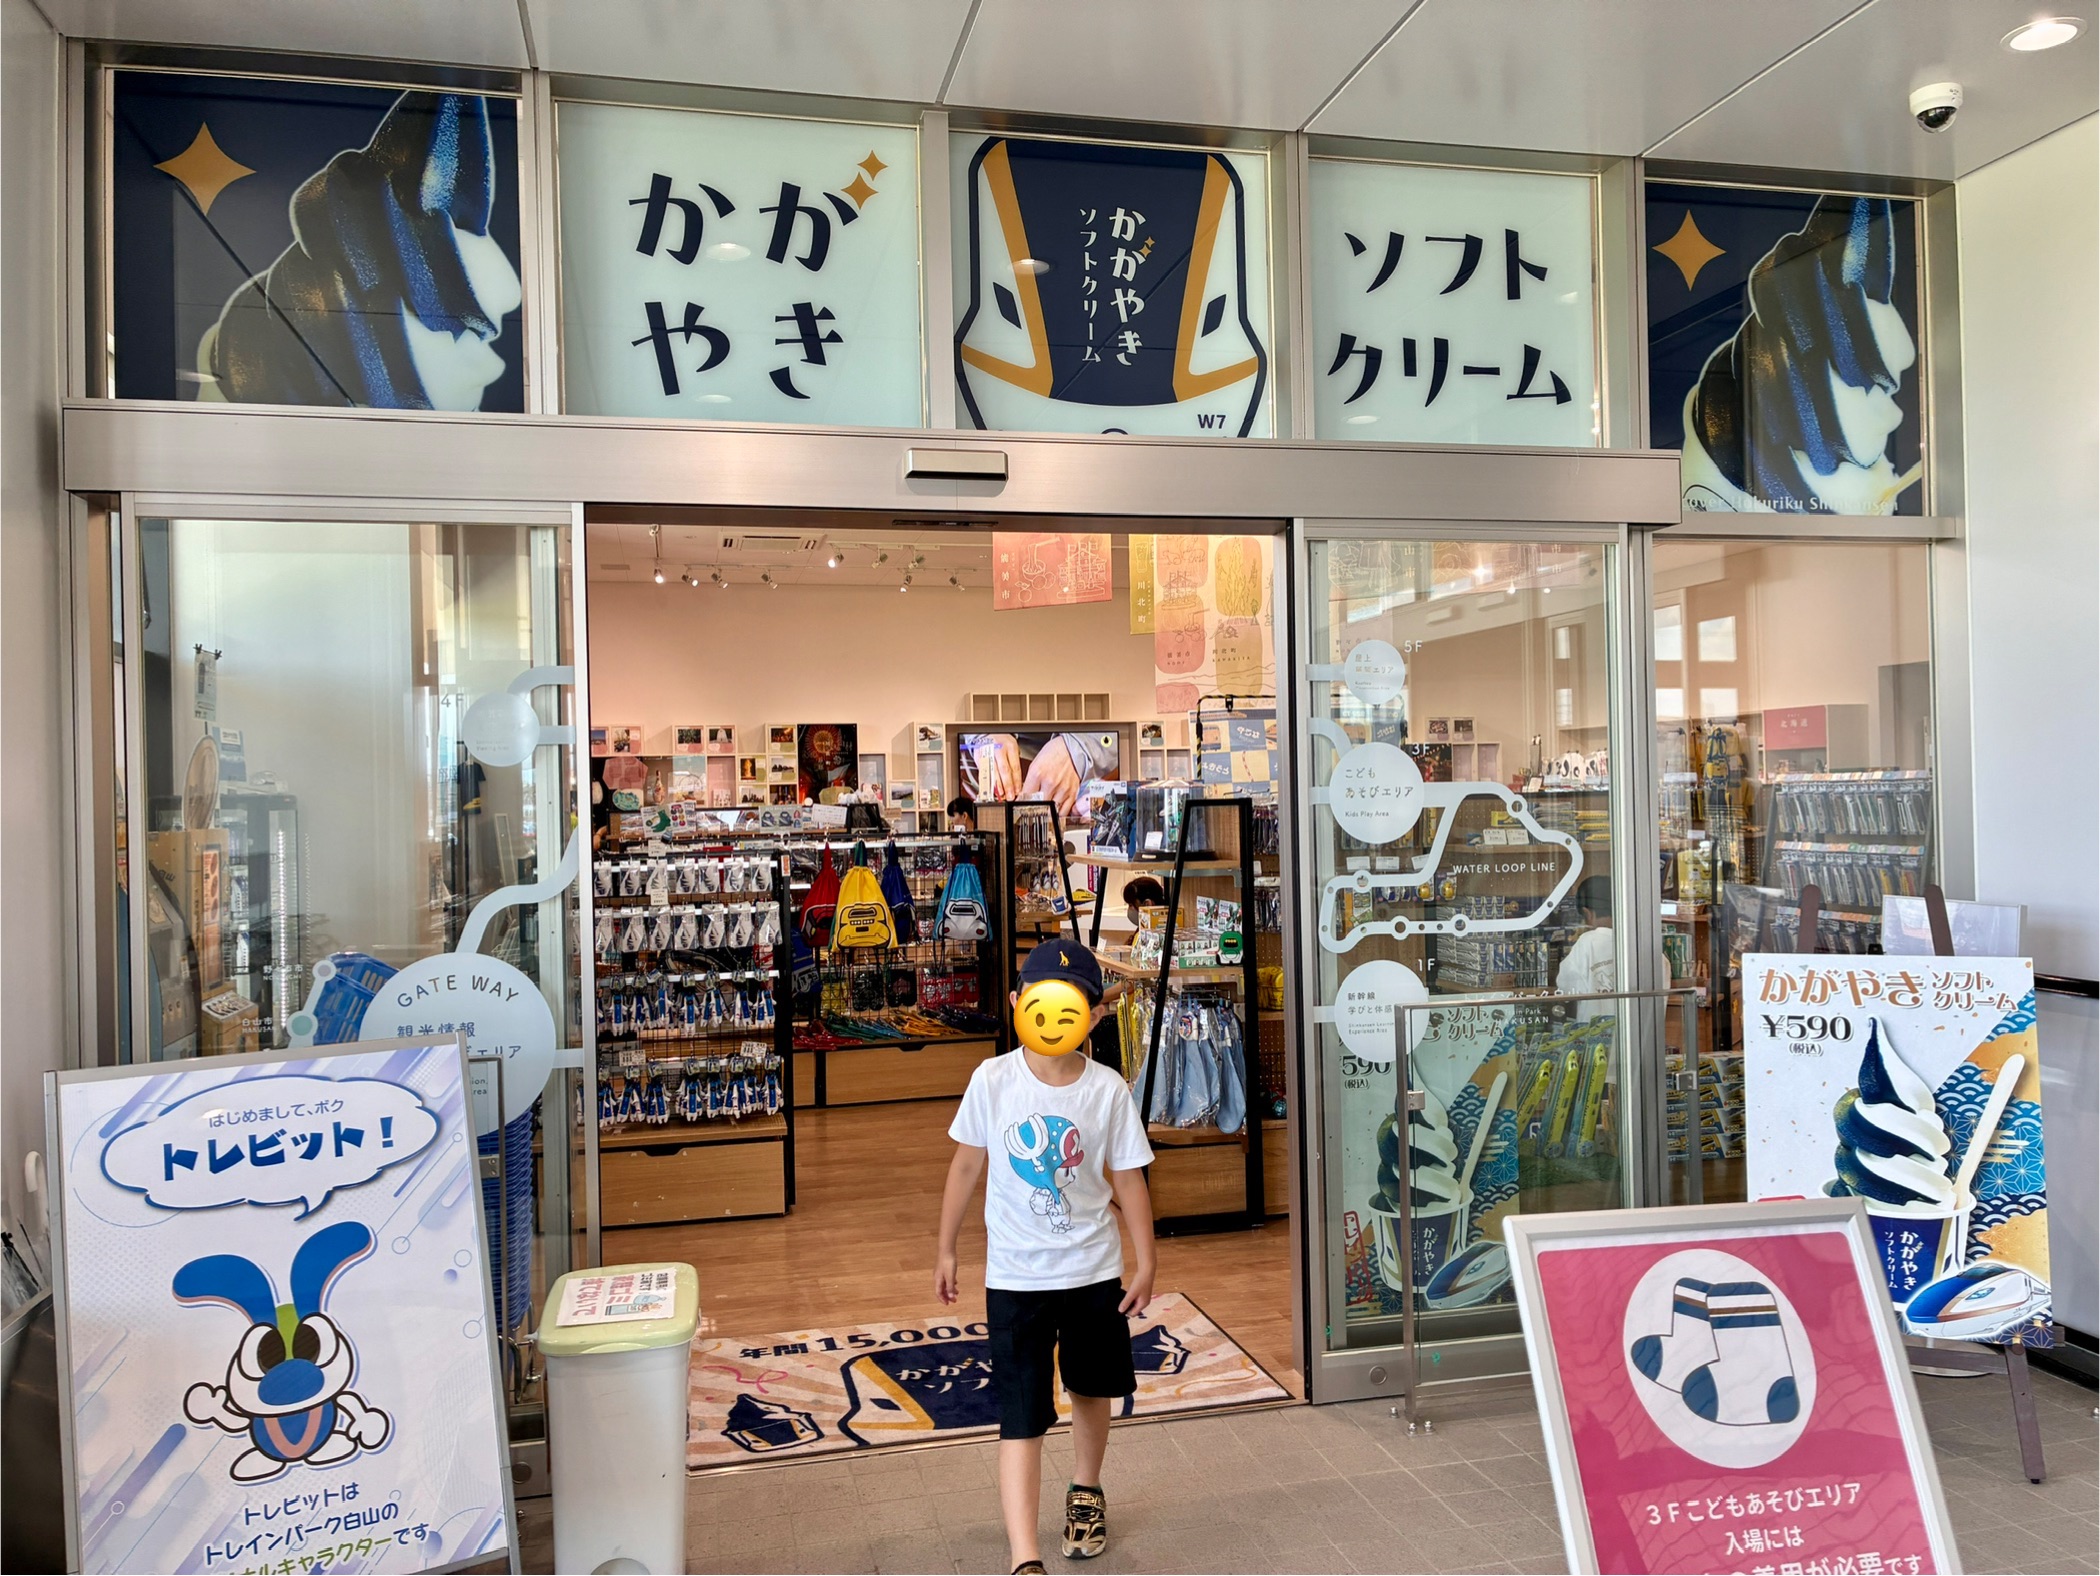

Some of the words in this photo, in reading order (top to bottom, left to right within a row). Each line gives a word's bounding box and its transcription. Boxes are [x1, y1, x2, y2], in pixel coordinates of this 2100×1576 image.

[629, 172, 862, 272] かが
[1344, 229, 1549, 301] ソフト
[1080, 208, 1101, 363] ソフトクリーム
[1109, 207, 1146, 366] かがやき
[632, 301, 844, 400] やき
[1327, 333, 1572, 408] クリーム
[1198, 414, 1226, 430] W7
[1735, 497, 1803, 511] Hokuriku
[1404, 640, 1422, 653] 5F
[440, 693, 464, 708] 4F
[1411, 742, 1430, 756] 3F
[1345, 767, 1375, 779] こども
[1345, 785, 1414, 799] あそびエリア
[1452, 864, 1491, 874] WATER
[1494, 862, 1526, 873] LOOP
[1530, 862, 1556, 872] LINE
[1417, 958, 1436, 972] 1F
[397, 974, 458, 1008] GATE
[471, 974, 519, 1002] WAY
[1759, 968, 1925, 1008] かがやき
[1932, 971, 1994, 991] ソフト
[1347, 991, 1376, 1001] 新幹線
[1933, 991, 2018, 1012] クリーム
[1447, 1006, 1488, 1023] ソフト
[1525, 1007, 1542, 1015] Park
[1447, 1023, 1505, 1042] クリーム
[1762, 1014, 1852, 1042] ¥590
[209, 1098, 345, 1128] はじめまして、ボク
[1424, 1227, 1436, 1276] かがやき
[1884, 1231, 1899, 1289] ソフトクリーム
[1899, 1230, 1920, 1291] かがやき
[244, 1482, 360, 1526] トレビットは
[206, 1502, 399, 1566] トレインパーク白山の
[1725, 1525, 1805, 1556] 入場には
